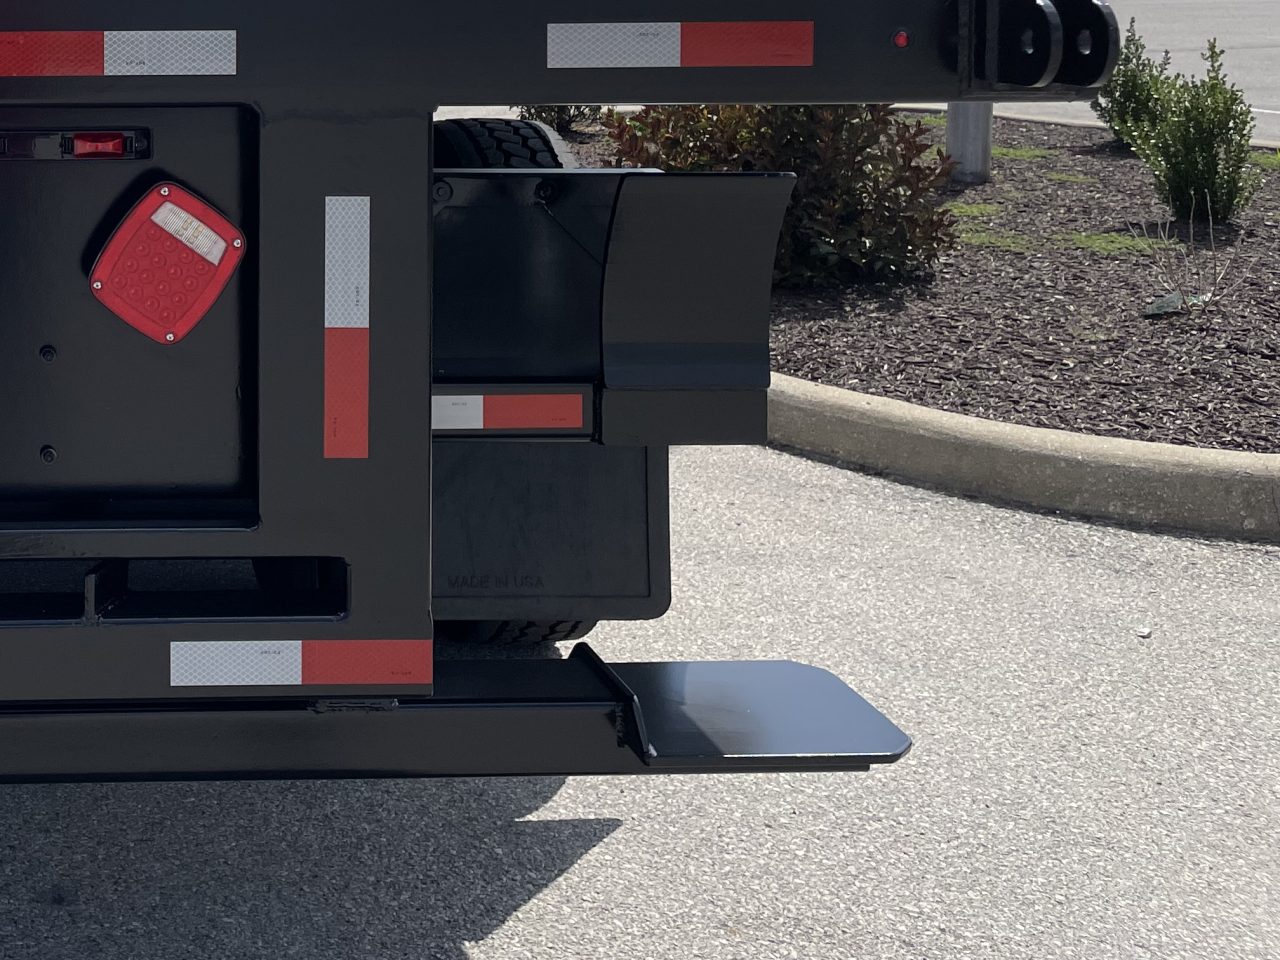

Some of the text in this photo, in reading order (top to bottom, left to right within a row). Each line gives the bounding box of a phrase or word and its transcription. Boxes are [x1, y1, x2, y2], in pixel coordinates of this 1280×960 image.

[448, 574, 545, 590] MADE IN USA
